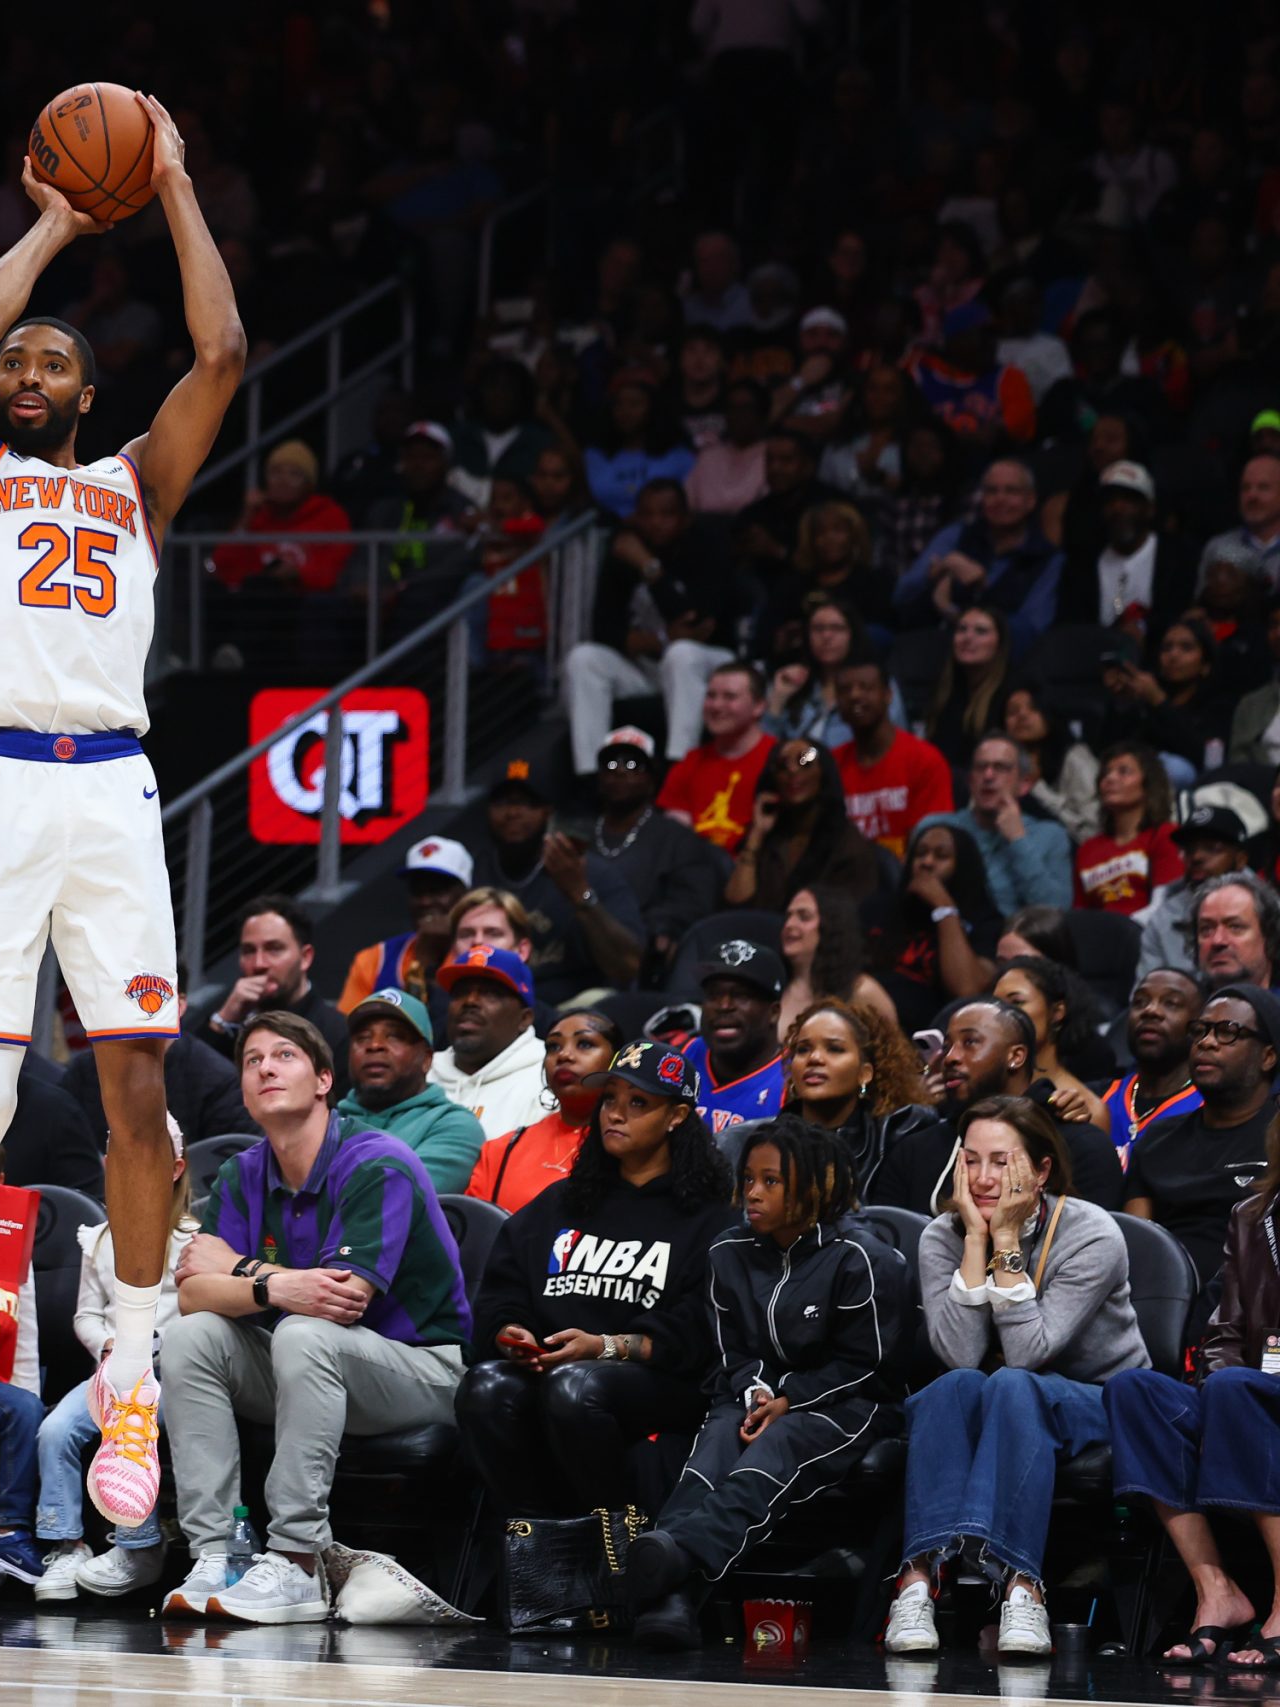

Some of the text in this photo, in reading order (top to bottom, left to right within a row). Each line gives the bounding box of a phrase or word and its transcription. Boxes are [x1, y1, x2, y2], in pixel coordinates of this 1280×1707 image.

[69, 479, 137, 541] YORK
[18, 522, 118, 618] 25
[267, 709, 401, 822] QT
[125, 974, 174, 1000] KNICKS
[543, 1273, 661, 1309] ESSENTIALS
[566, 1233, 671, 1291] NBA
